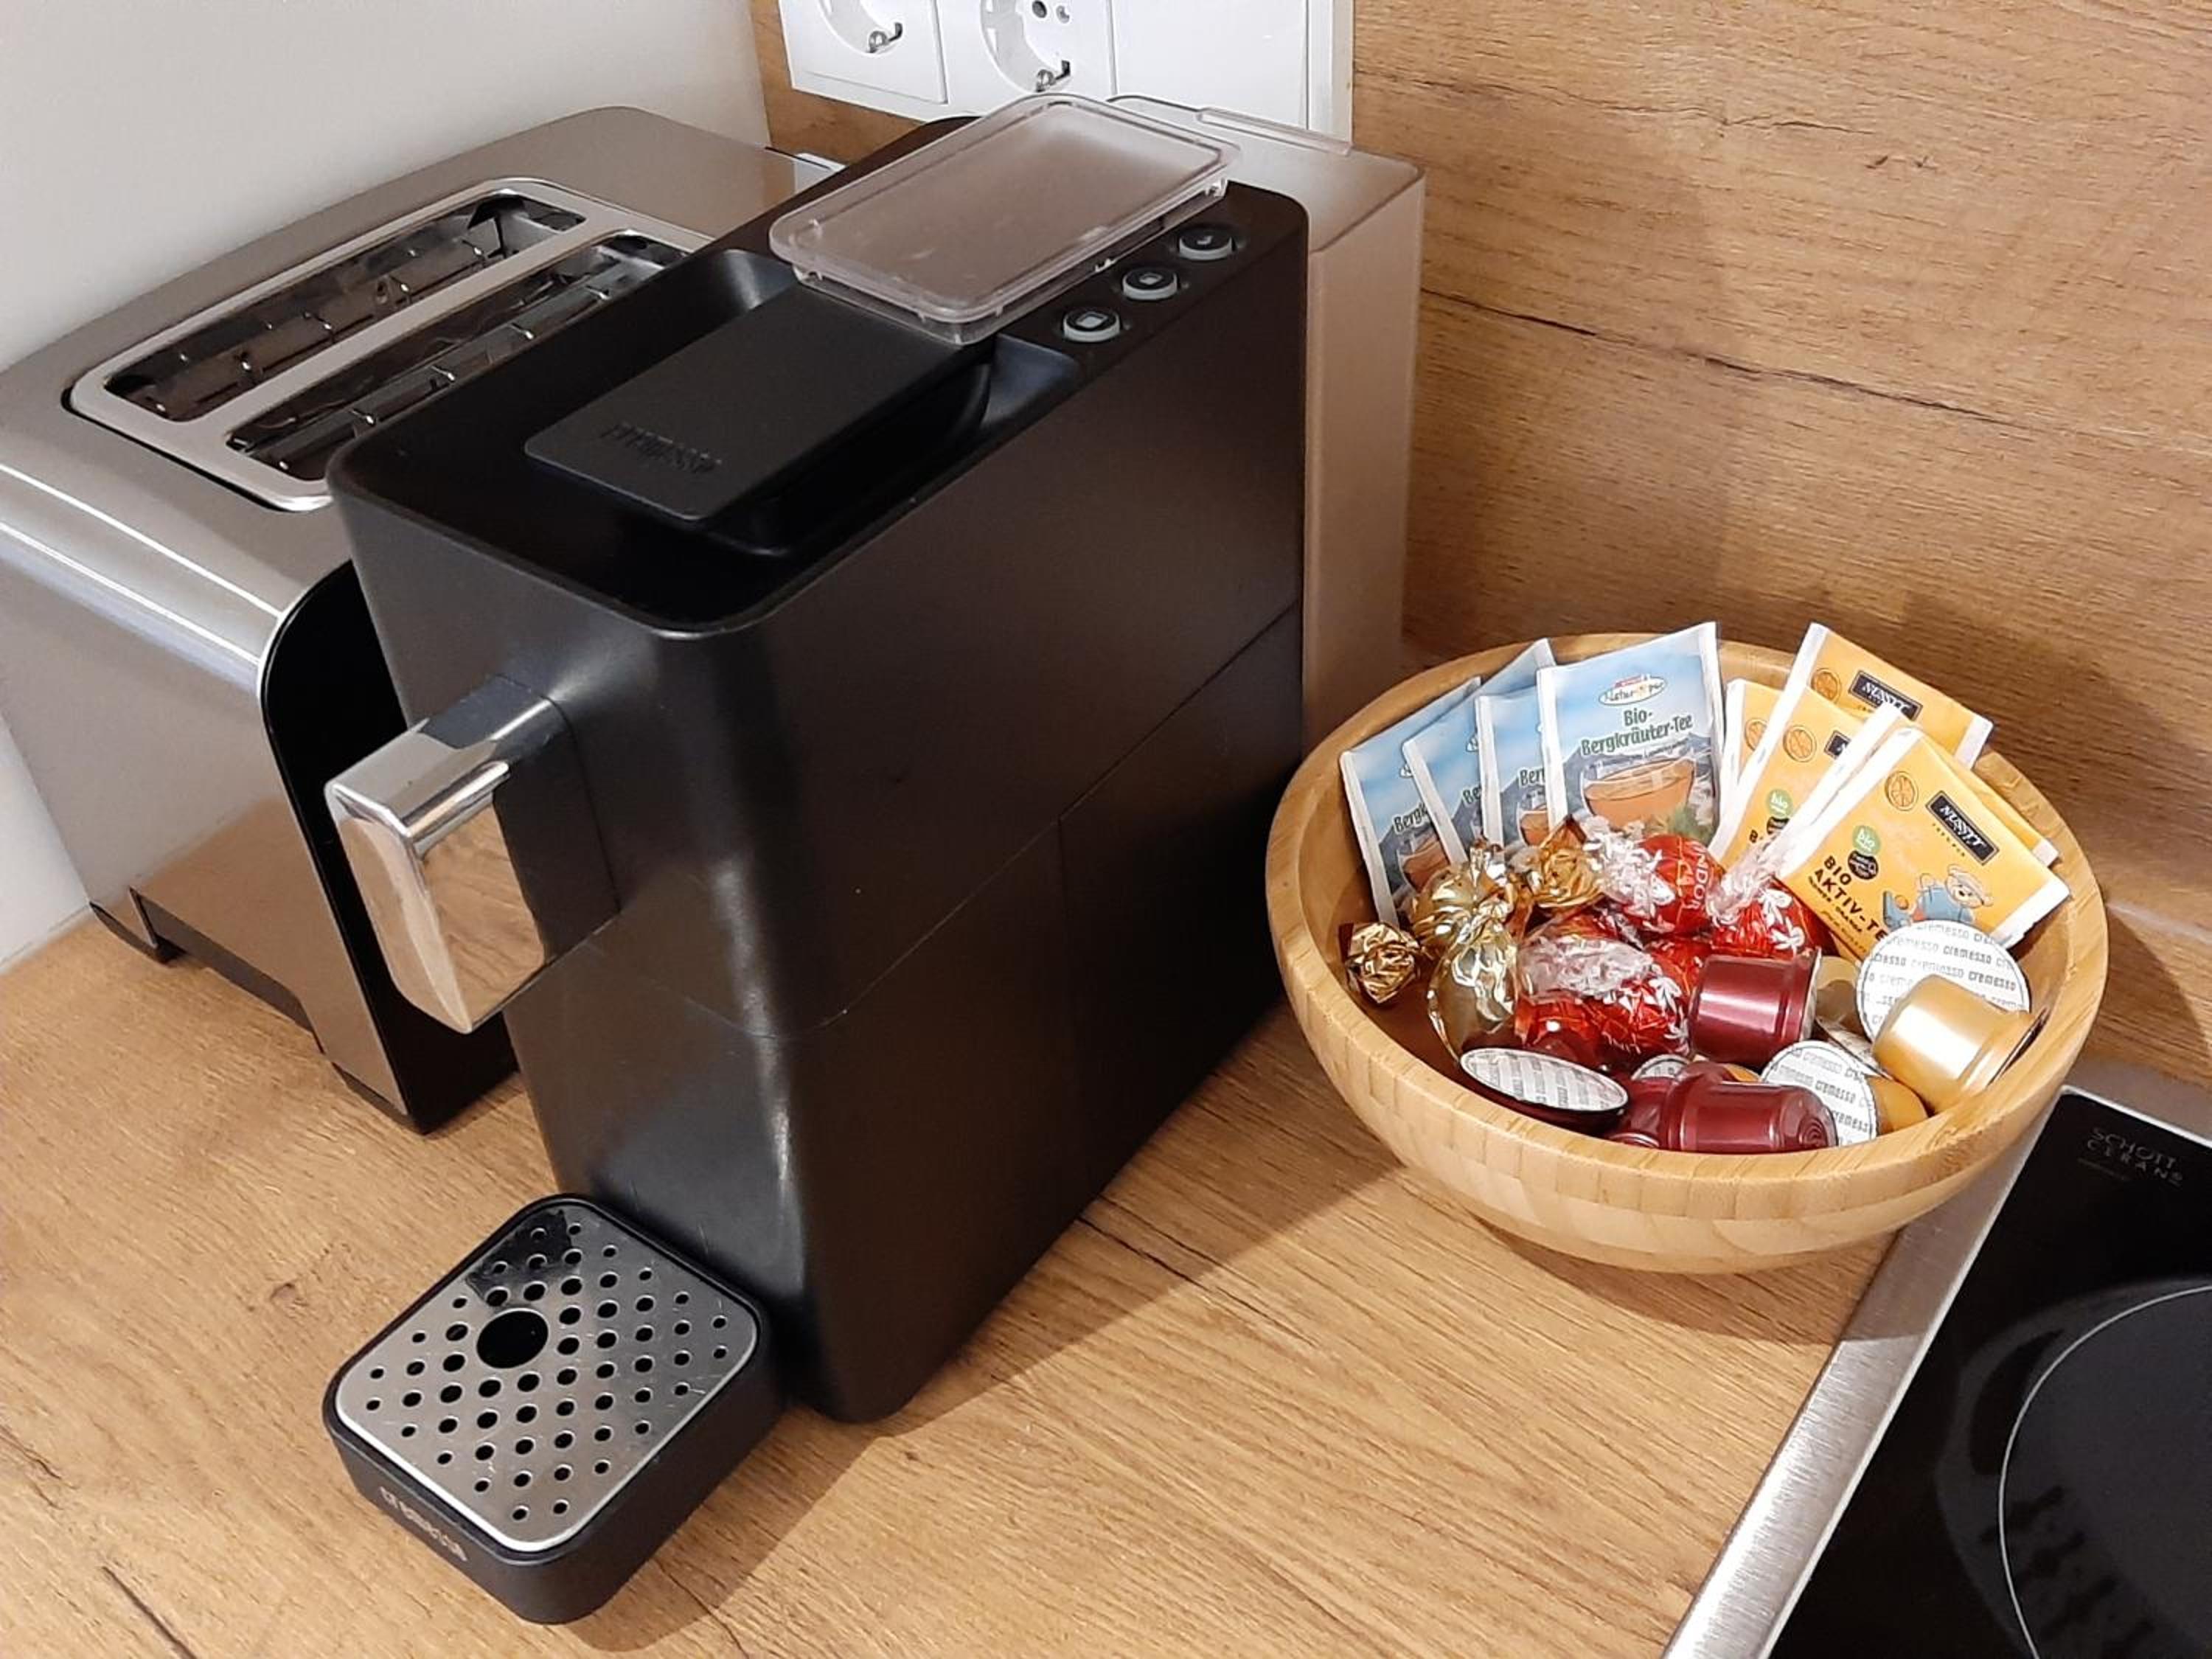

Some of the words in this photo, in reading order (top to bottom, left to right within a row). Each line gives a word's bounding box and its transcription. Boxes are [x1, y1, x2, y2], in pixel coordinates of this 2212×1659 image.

[1581, 714, 1694, 756] Bergkräuter-Tee
[1624, 708, 1653, 726] Bio-
[1823, 855, 1852, 886] BIO
[1815, 869, 1888, 942] AKTIV-TE
